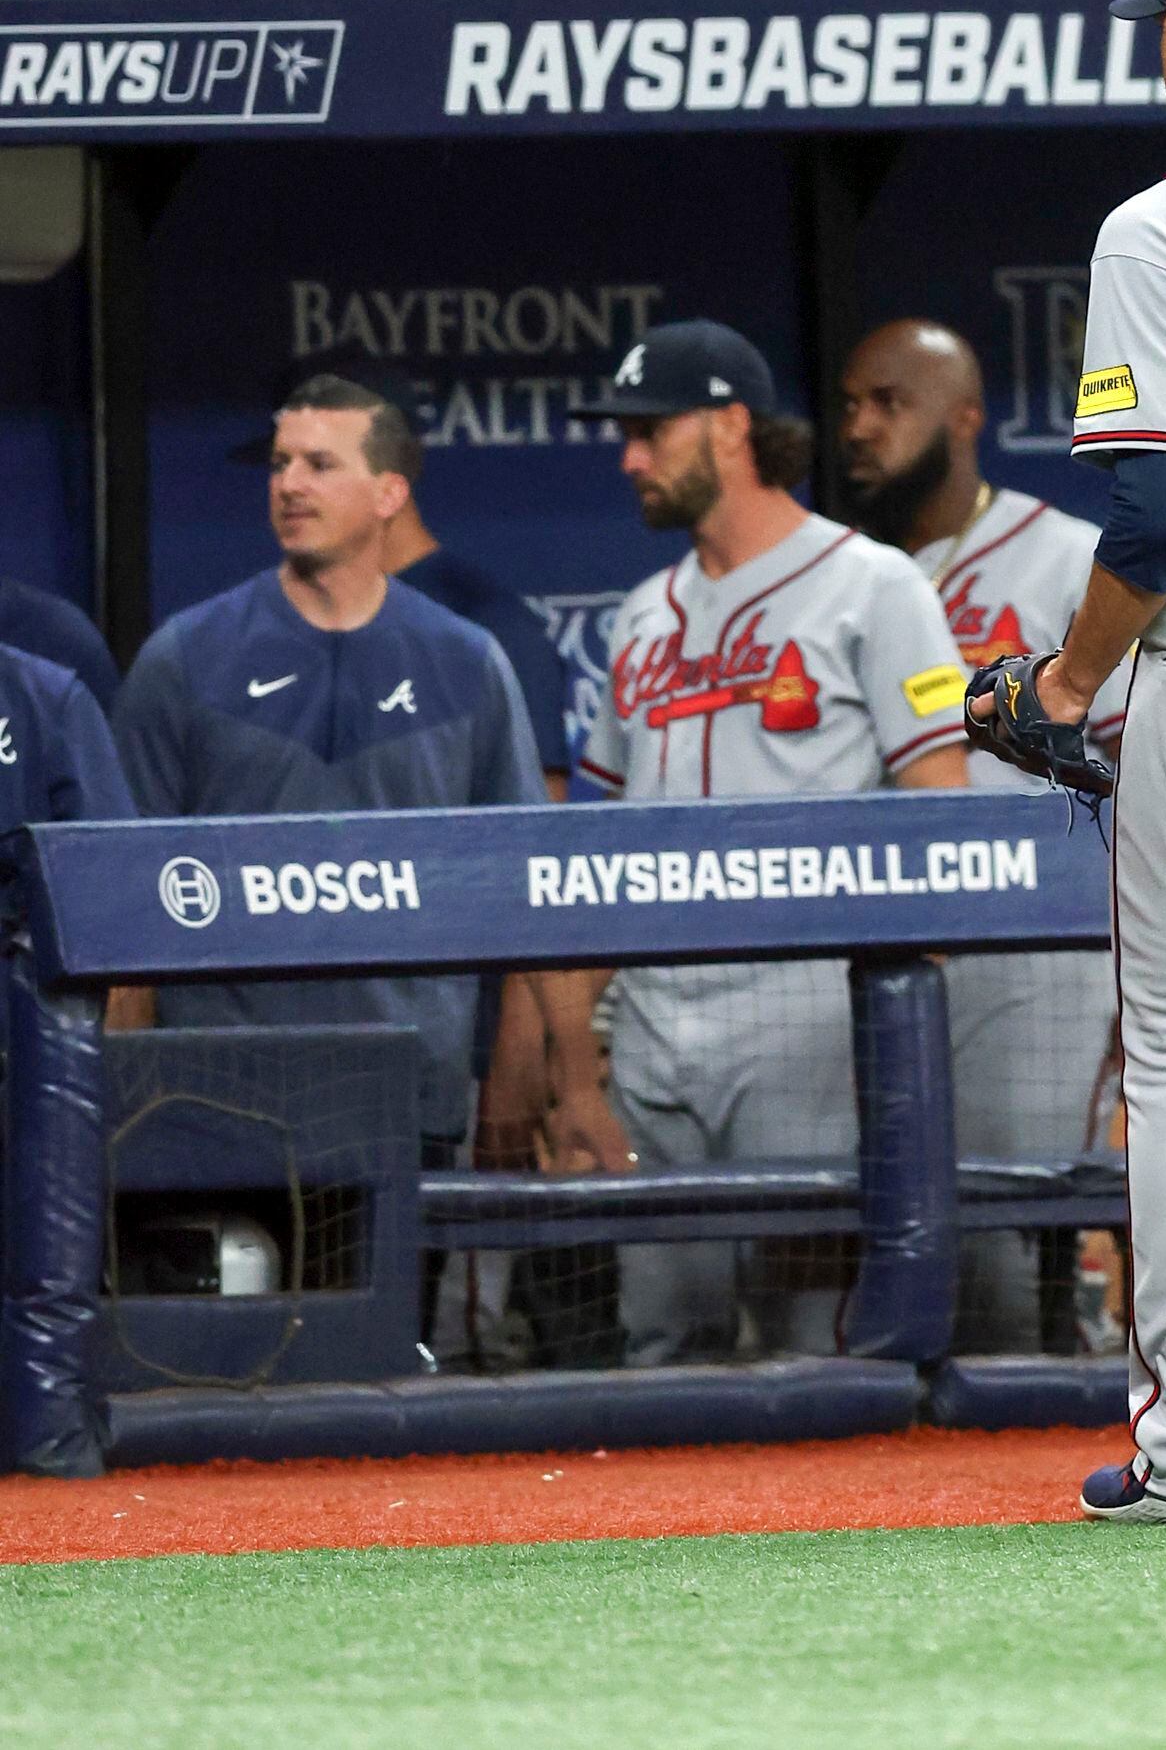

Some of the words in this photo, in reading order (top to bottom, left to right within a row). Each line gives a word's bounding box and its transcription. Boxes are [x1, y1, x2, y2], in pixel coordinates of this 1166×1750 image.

[0, 38, 248, 105] RAYSUP
[1082, 374, 1131, 398] QUIKRETE
[240, 859, 421, 916] BOSCH
[527, 837, 1038, 908] RAYSBASEBALL.COM
